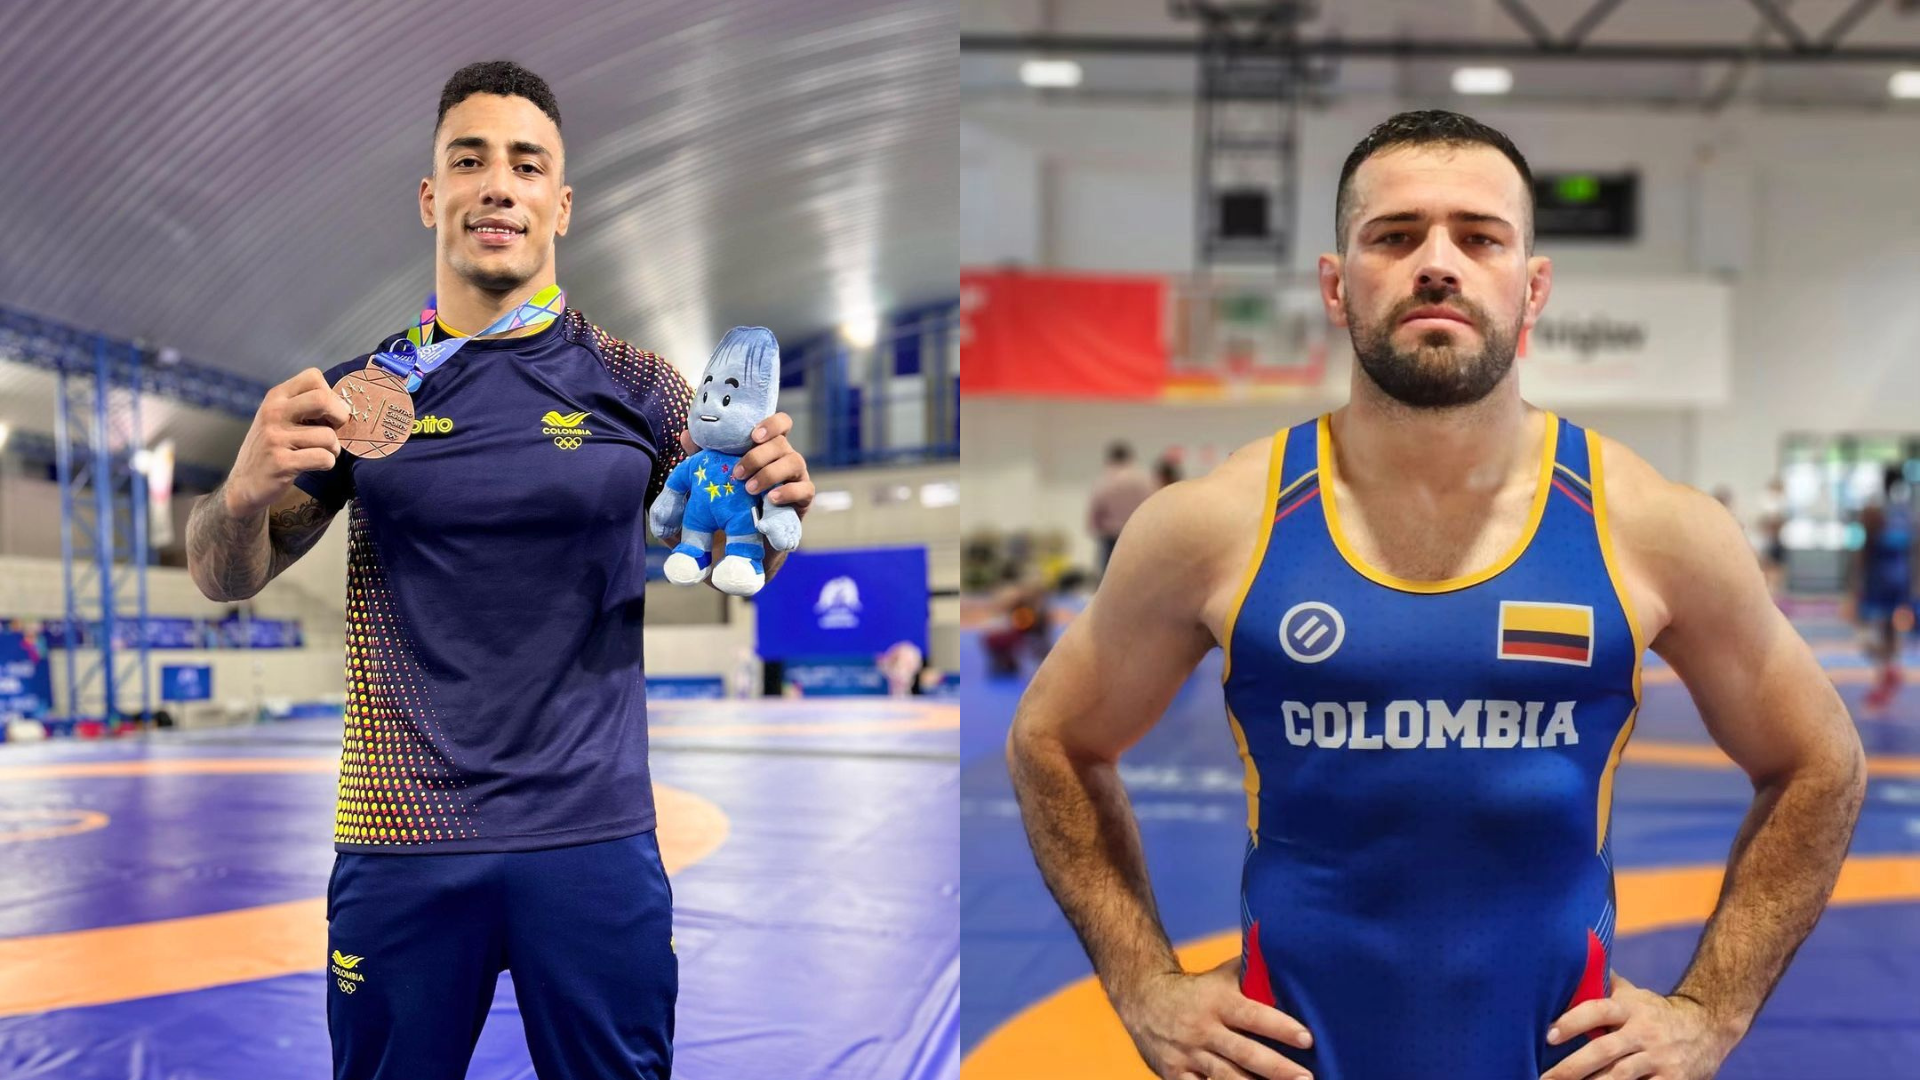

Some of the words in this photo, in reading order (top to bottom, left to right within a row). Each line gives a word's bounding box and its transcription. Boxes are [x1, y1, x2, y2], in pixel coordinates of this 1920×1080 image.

[412, 415, 453, 434] otto
[542, 427, 592, 436] COLOMBIA
[1281, 699, 1579, 750] COLOMBIA
[331, 965, 365, 982] COLOMBIA
